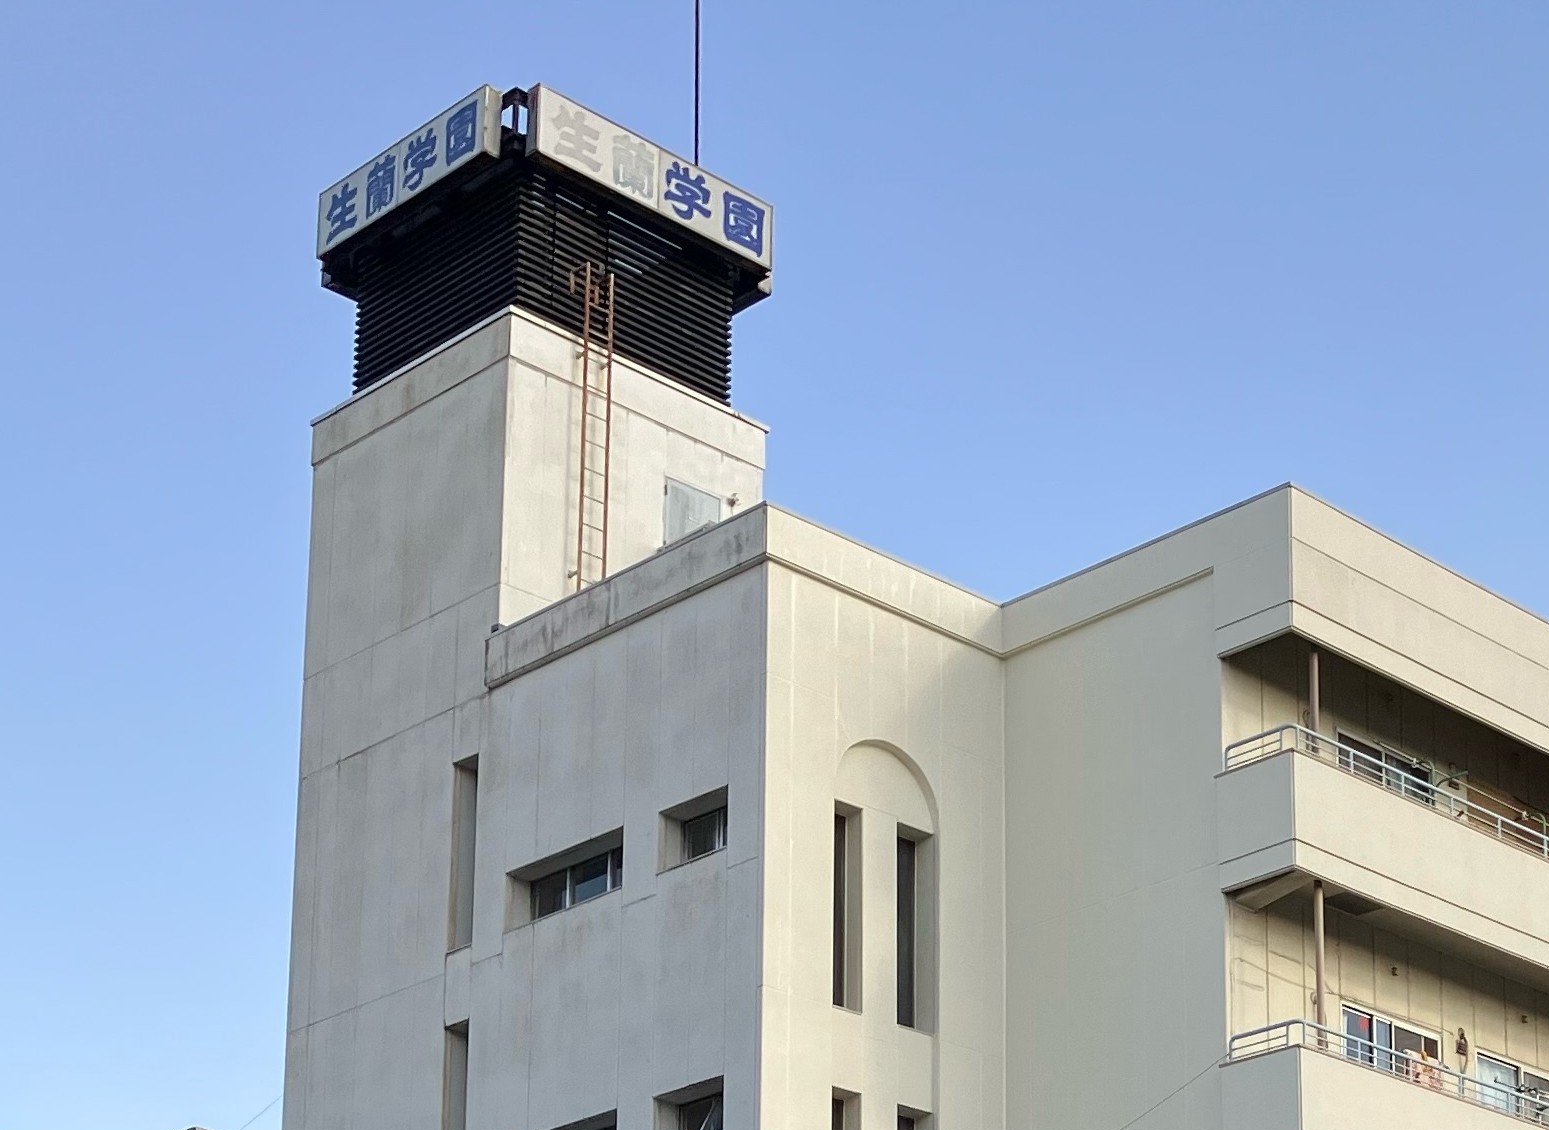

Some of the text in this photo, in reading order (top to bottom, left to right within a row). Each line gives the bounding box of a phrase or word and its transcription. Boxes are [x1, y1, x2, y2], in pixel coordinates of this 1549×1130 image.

[325, 99, 478, 246] 生蘭学園
[549, 103, 766, 258] 生蘭学園
